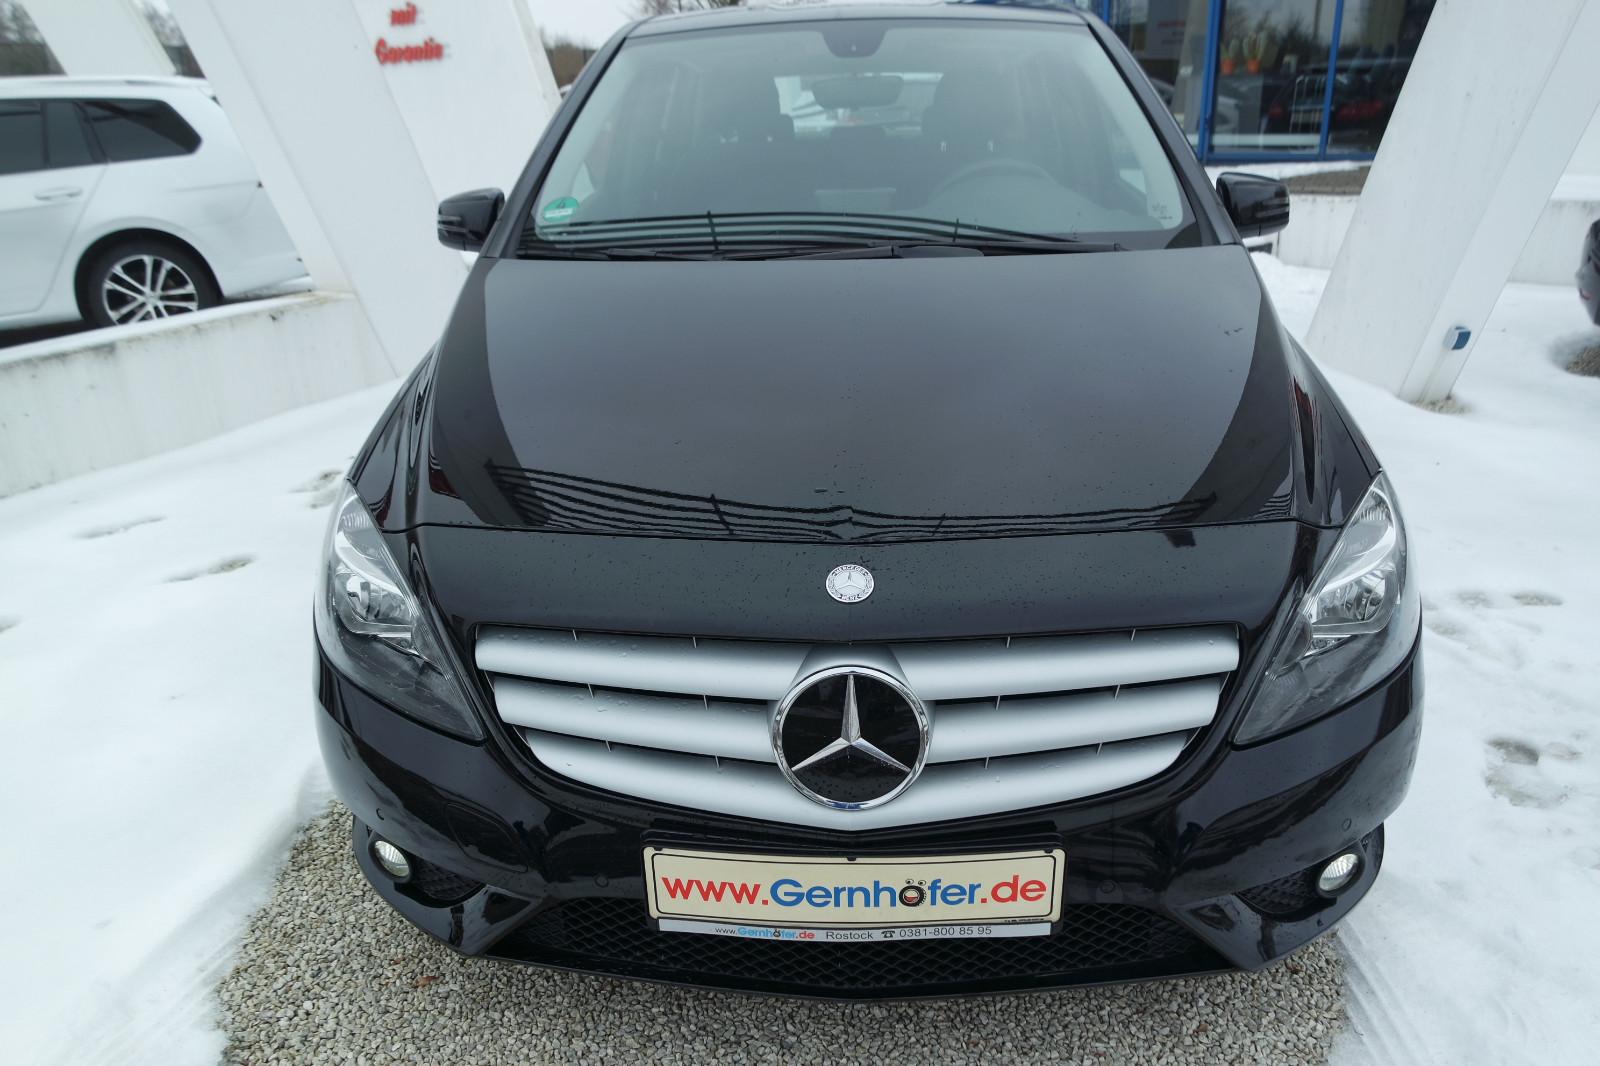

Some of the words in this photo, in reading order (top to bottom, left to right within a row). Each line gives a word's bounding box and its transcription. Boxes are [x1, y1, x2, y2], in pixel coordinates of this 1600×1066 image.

[661, 875, 1047, 908] www.Gernhöfer.de
[826, 930, 873, 940] Rostock
[899, 926, 955, 938] 0381-800
[958, 926, 974, 936] 85
[977, 926, 992, 936] 95
